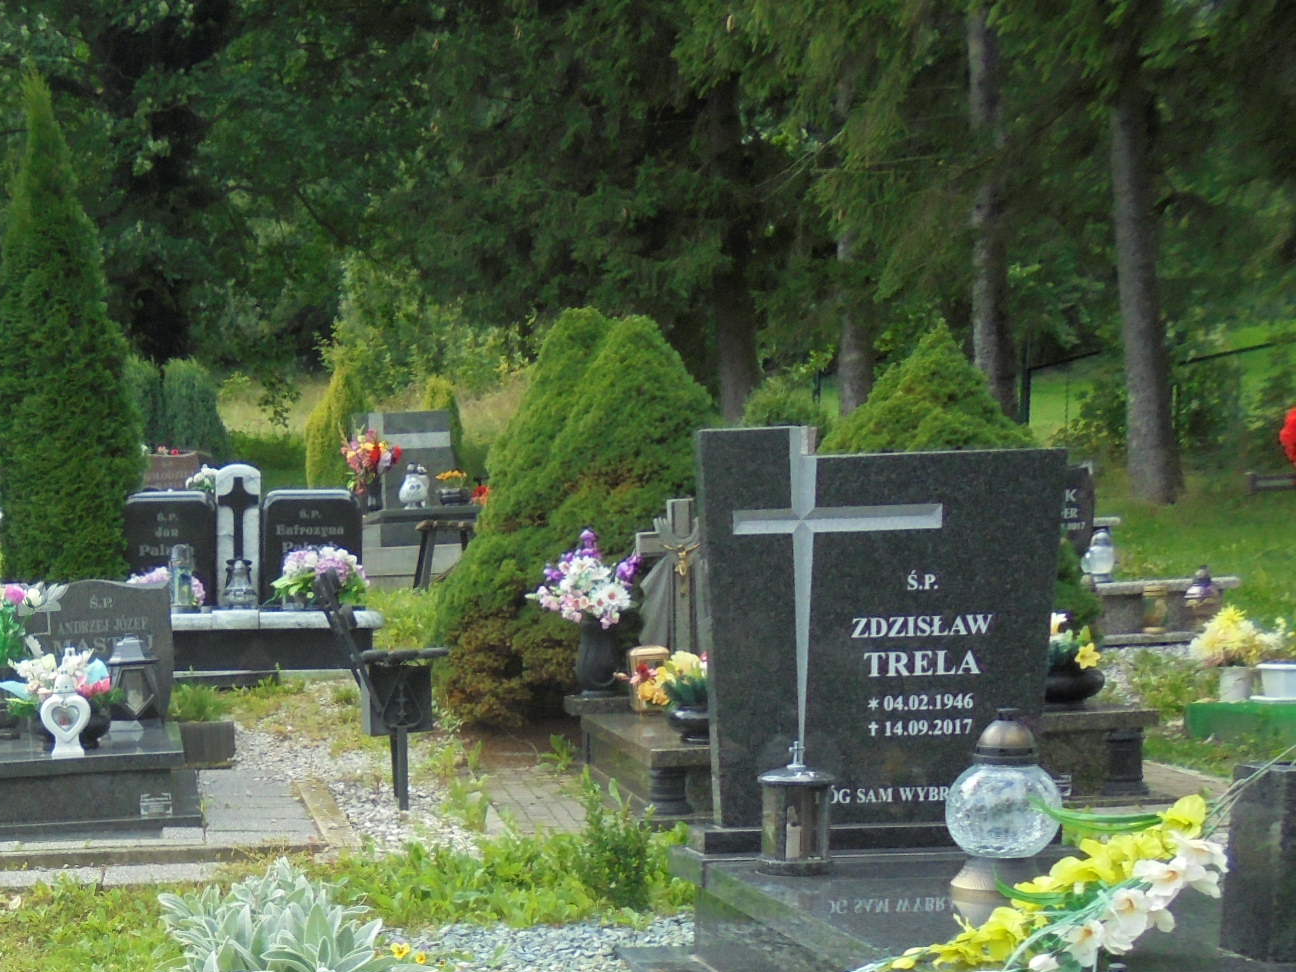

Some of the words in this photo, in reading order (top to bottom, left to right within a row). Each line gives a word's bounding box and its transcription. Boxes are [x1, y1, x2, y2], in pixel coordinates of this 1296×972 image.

[154, 526, 179, 538] Jan
[907, 569, 939, 591] Ś.P.
[58, 618, 110, 636] ANDRZEJ
[850, 613, 994, 639] ZDZISŁAW
[52, 633, 155, 656] MASTJ
[863, 649, 982, 678] TRELA
[883, 692, 975, 712] 04.02.1946
[884, 718, 974, 737] 14.09.2017
[831, 784, 851, 804] ÓG
[856, 787, 893, 804] SAM
[898, 785, 950, 803] WYBR
